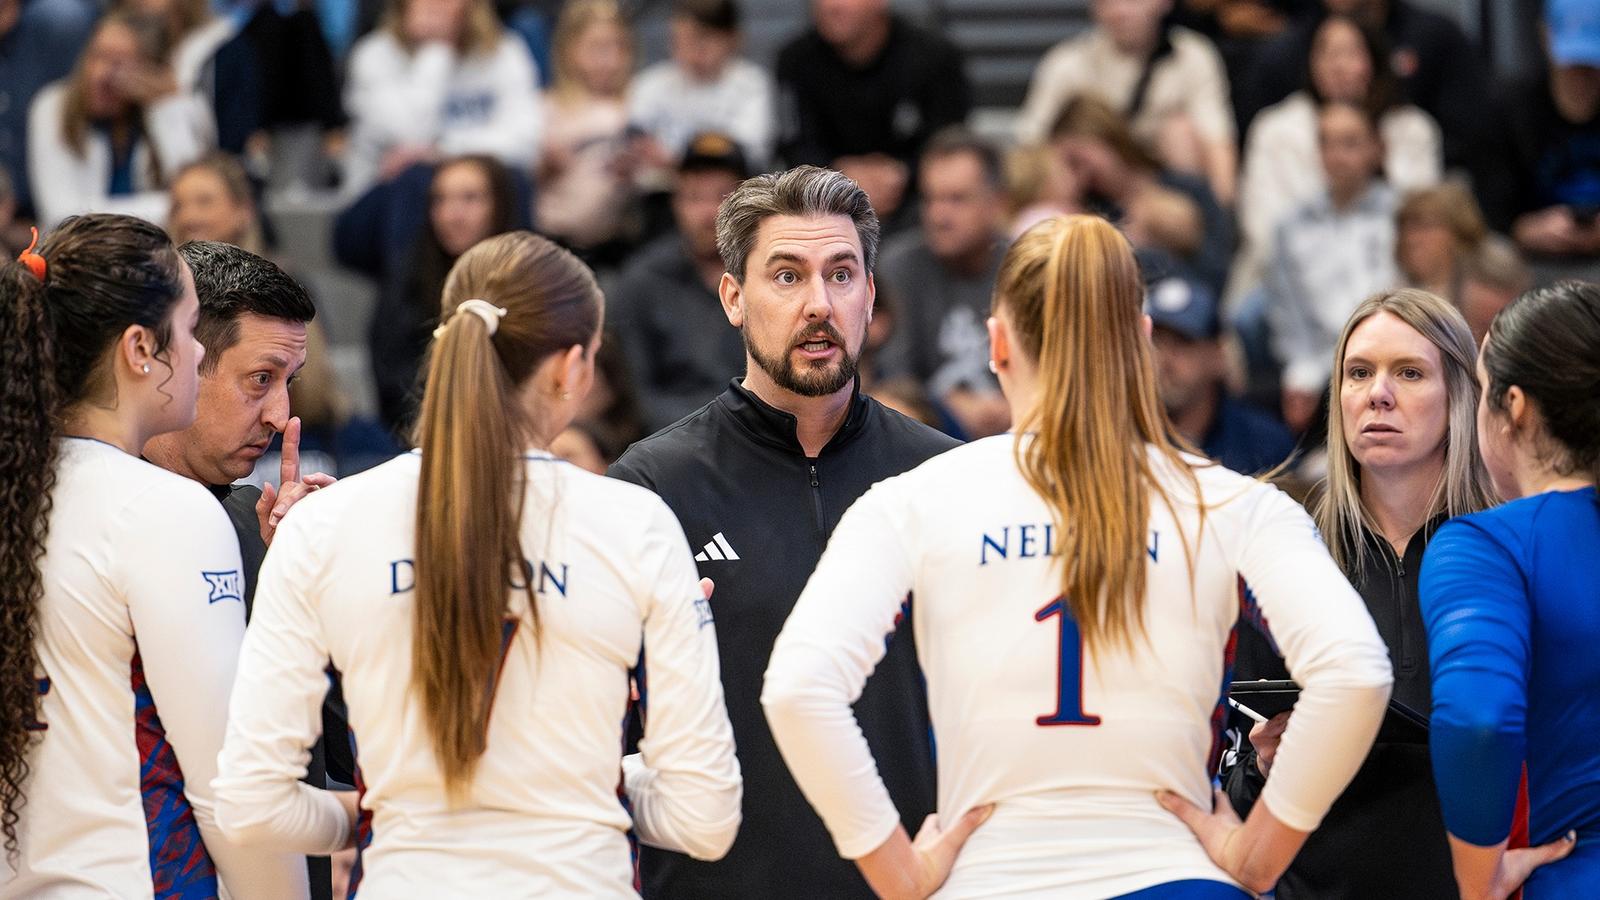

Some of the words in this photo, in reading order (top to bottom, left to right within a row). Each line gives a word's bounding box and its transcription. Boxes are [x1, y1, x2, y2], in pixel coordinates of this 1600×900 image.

[979, 524, 1161, 566] NELN
[390, 558, 570, 597] DON
[1034, 593, 1103, 727] 1
